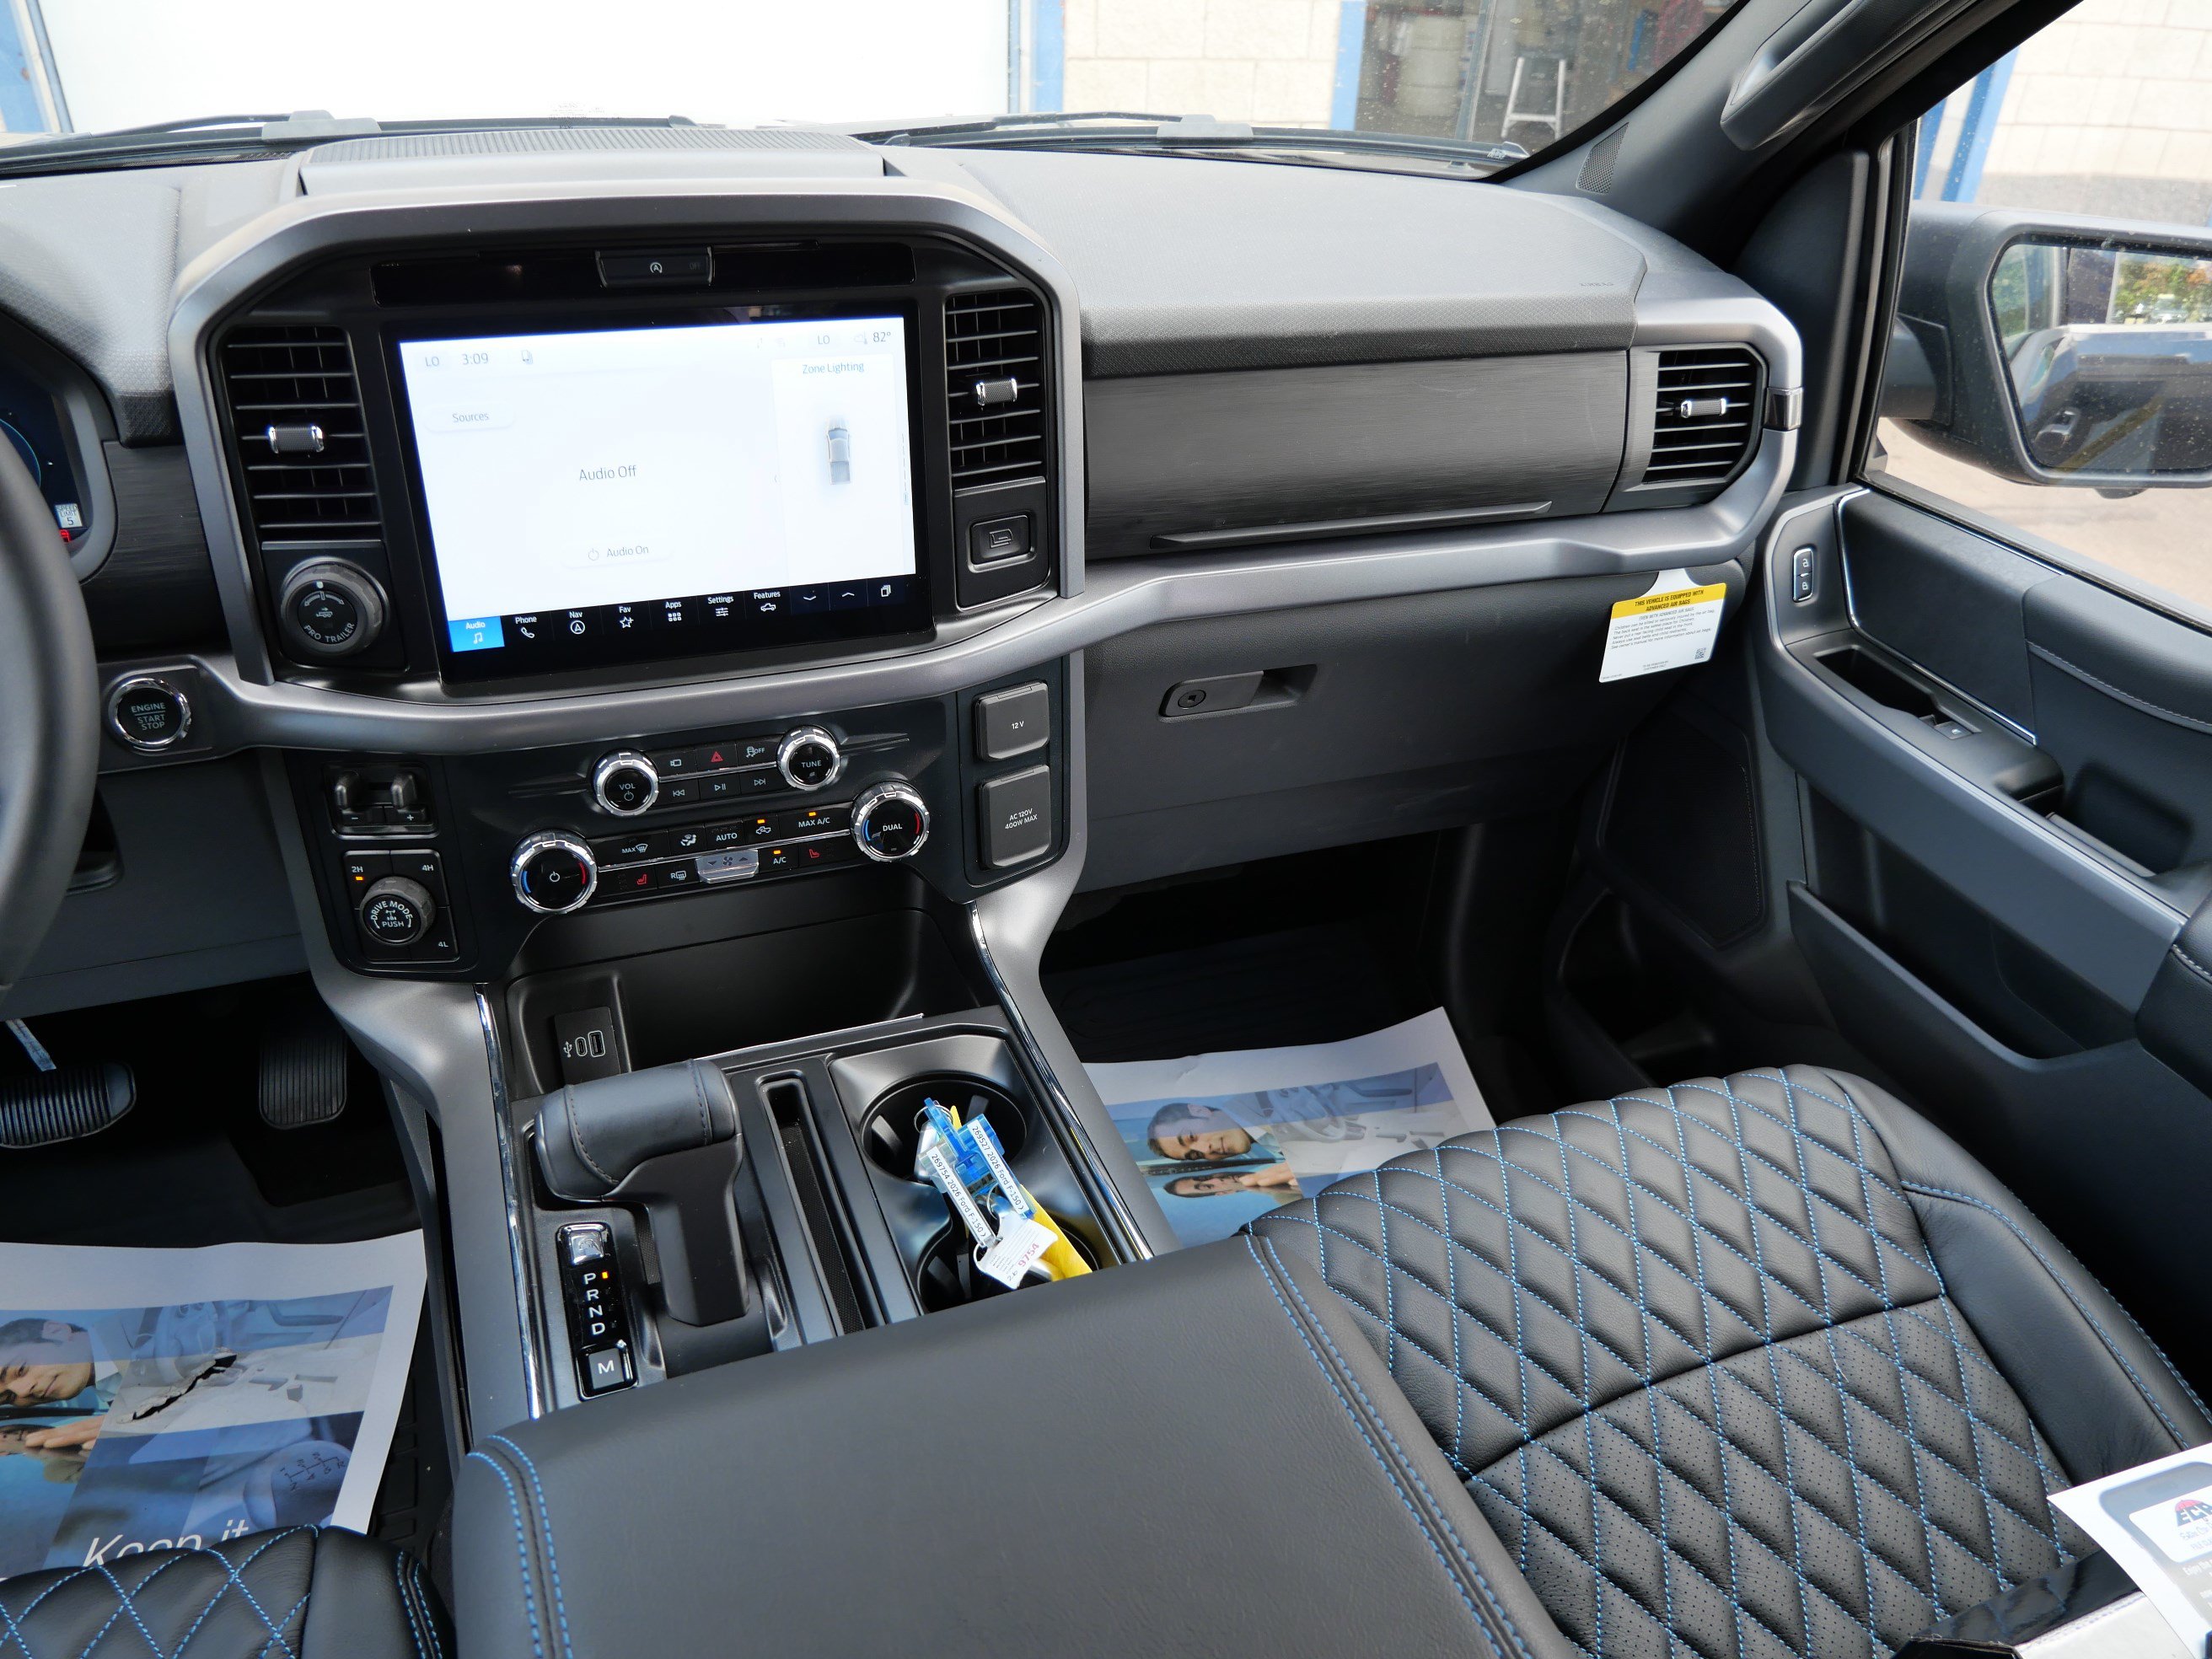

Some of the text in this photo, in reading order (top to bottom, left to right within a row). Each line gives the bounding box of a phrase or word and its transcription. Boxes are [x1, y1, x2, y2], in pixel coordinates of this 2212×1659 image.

[818, 336, 830, 345] LO
[425, 356, 440, 368] LO
[462, 352, 489, 366] 3:09
[803, 362, 865, 374] Zone Lighting
[452, 411, 490, 423] Sources
[579, 464, 637, 481] Audio Off
[67, 517, 74, 526] 5
[606, 545, 649, 557] Audio On
[707, 595, 734, 604] Settings
[754, 591, 781, 599] Features
[1671, 591, 1691, 600] EQUIPPED
[665, 600, 682, 609] Apps
[1646, 603, 1669, 612] ADVANCED
[515, 616, 538, 625] Phone
[569, 610, 583, 619] Nav
[465, 621, 486, 630] Audio
[304, 622, 355, 642] PRO TRAILER
[131, 702, 166, 714] ENGINE
[137, 714, 165, 724] START
[142, 722, 165, 731] STOP
[801, 760, 822, 769] TUNE
[620, 782, 636, 791] VOL
[1009, 808, 1034, 821] AC 120V
[817, 817, 831, 826] A/C
[883, 823, 903, 832] DUAL
[1005, 814, 1038, 830] 400W MAX
[716, 832, 738, 842] AUTO
[773, 856, 787, 865] A/C
[370, 900, 413, 921] DRIVE MODE
[972, 1126, 991, 1151] 269527
[987, 1152, 1001, 1169] 2026
[998, 1169, 1010, 1185] Ford
[1007, 1185, 1022, 1205] F-150
[932, 1154, 950, 1179] 269754
[948, 1179, 961, 1197] 2026
[958, 1197, 970, 1213] Ford
[969, 1213, 984, 1232] F-150
[1017, 1243, 1039, 1267] 9754
[583, 1272, 597, 1285] P
[586, 1288, 600, 1301] R
[588, 1304, 604, 1318] N
[591, 1322, 606, 1335] D
[597, 1360, 615, 1374] M
